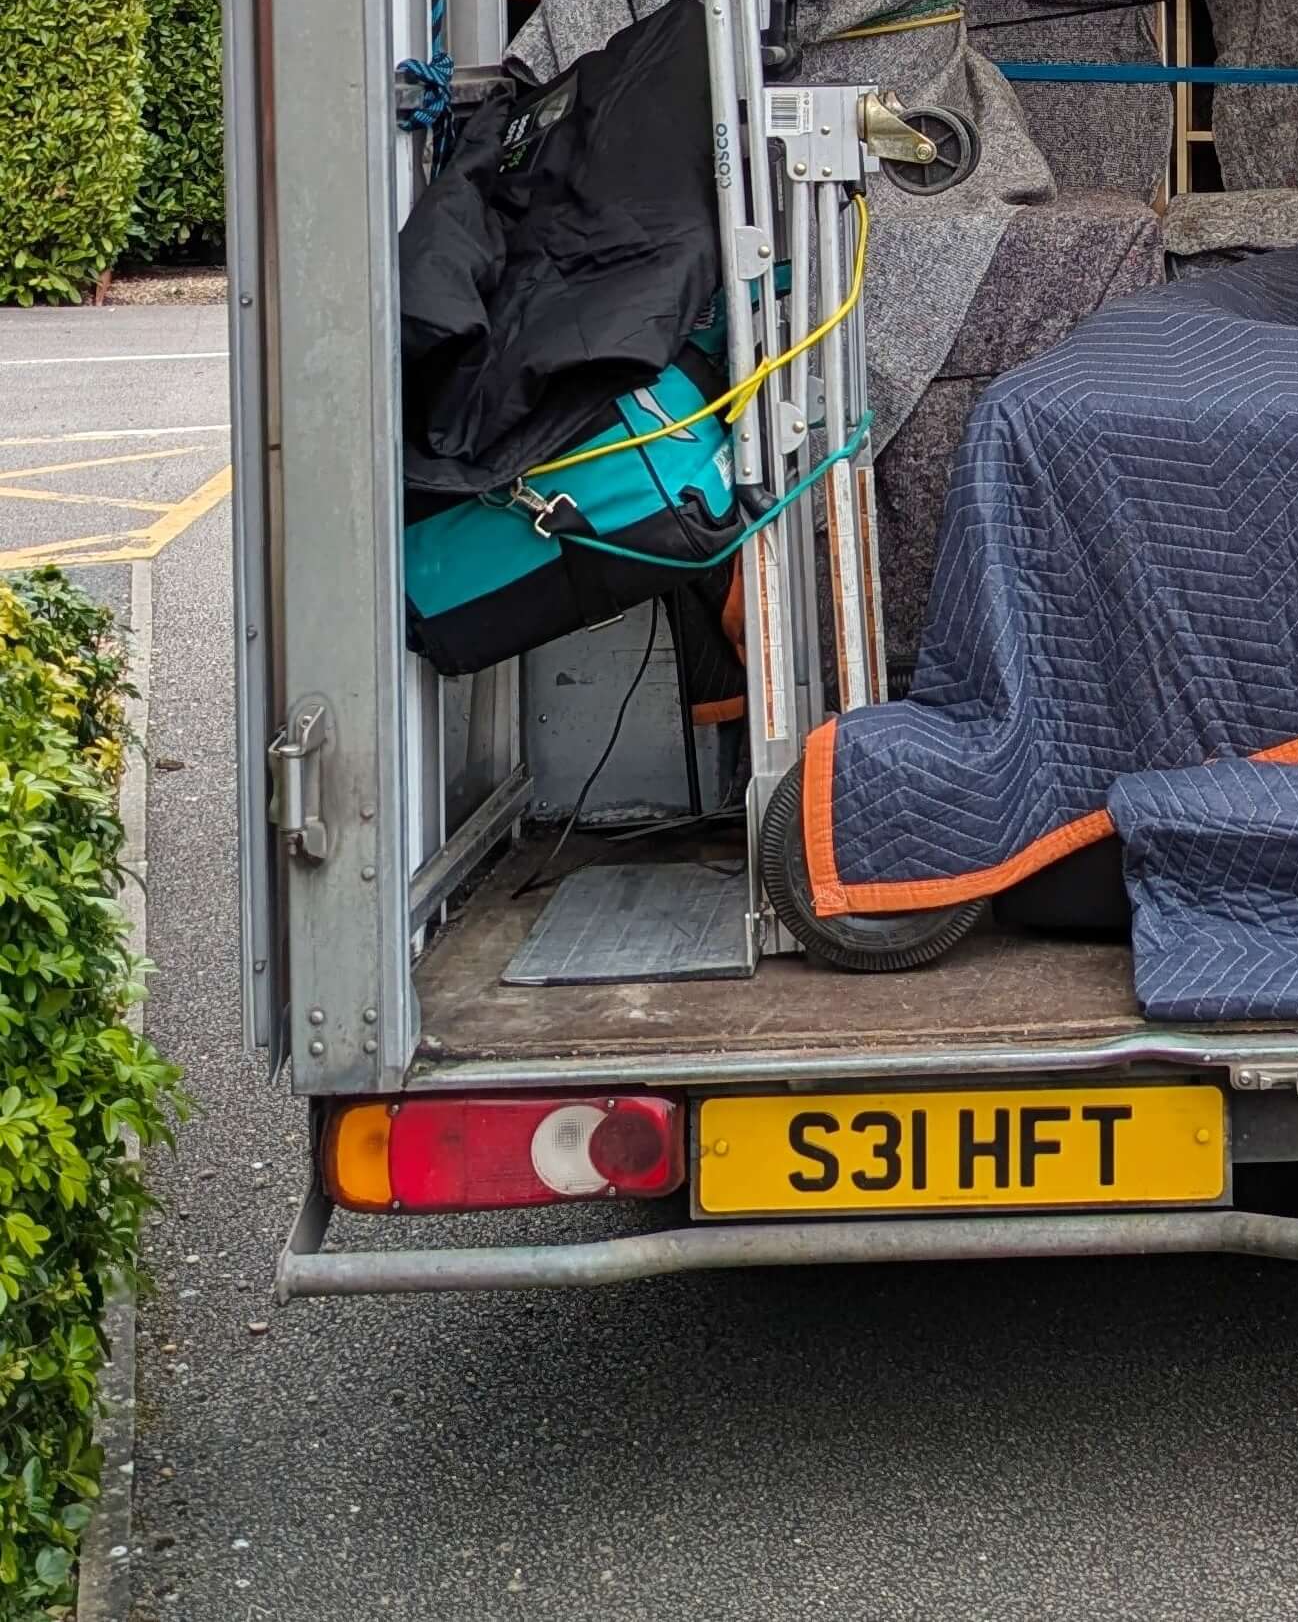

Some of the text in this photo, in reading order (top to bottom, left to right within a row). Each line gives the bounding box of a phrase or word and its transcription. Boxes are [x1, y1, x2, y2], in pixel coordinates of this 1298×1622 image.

[714, 122, 732, 189] COSCO
[788, 1104, 1133, 1193] S31 HFT
